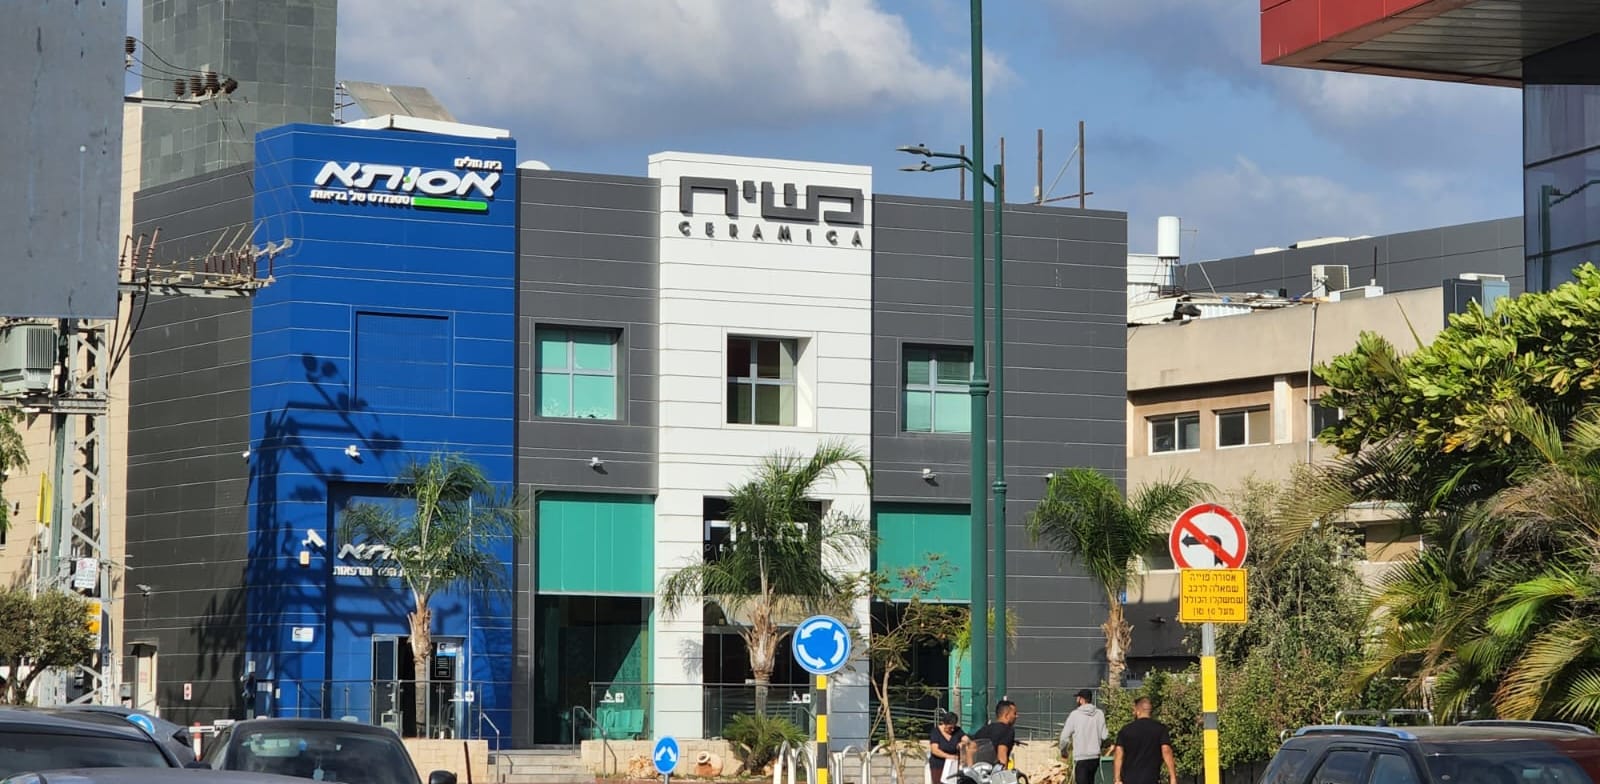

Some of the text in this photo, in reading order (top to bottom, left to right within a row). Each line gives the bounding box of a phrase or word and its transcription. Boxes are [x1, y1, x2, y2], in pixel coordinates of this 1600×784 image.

[454, 156, 502, 170] בית חולים
[314, 161, 500, 197] אסותא
[349, 190, 367, 202] של
[680, 176, 864, 228] כשיח
[678, 220, 863, 248] CERAMICA
[1213, 573, 1237, 582] אסורה
[1188, 584, 1239, 593] שמאלה לרכב
[1184, 595, 1244, 606] שמשקלו הכולל
[1193, 607, 1205, 617] טון
[1218, 607, 1235, 616] מעל
